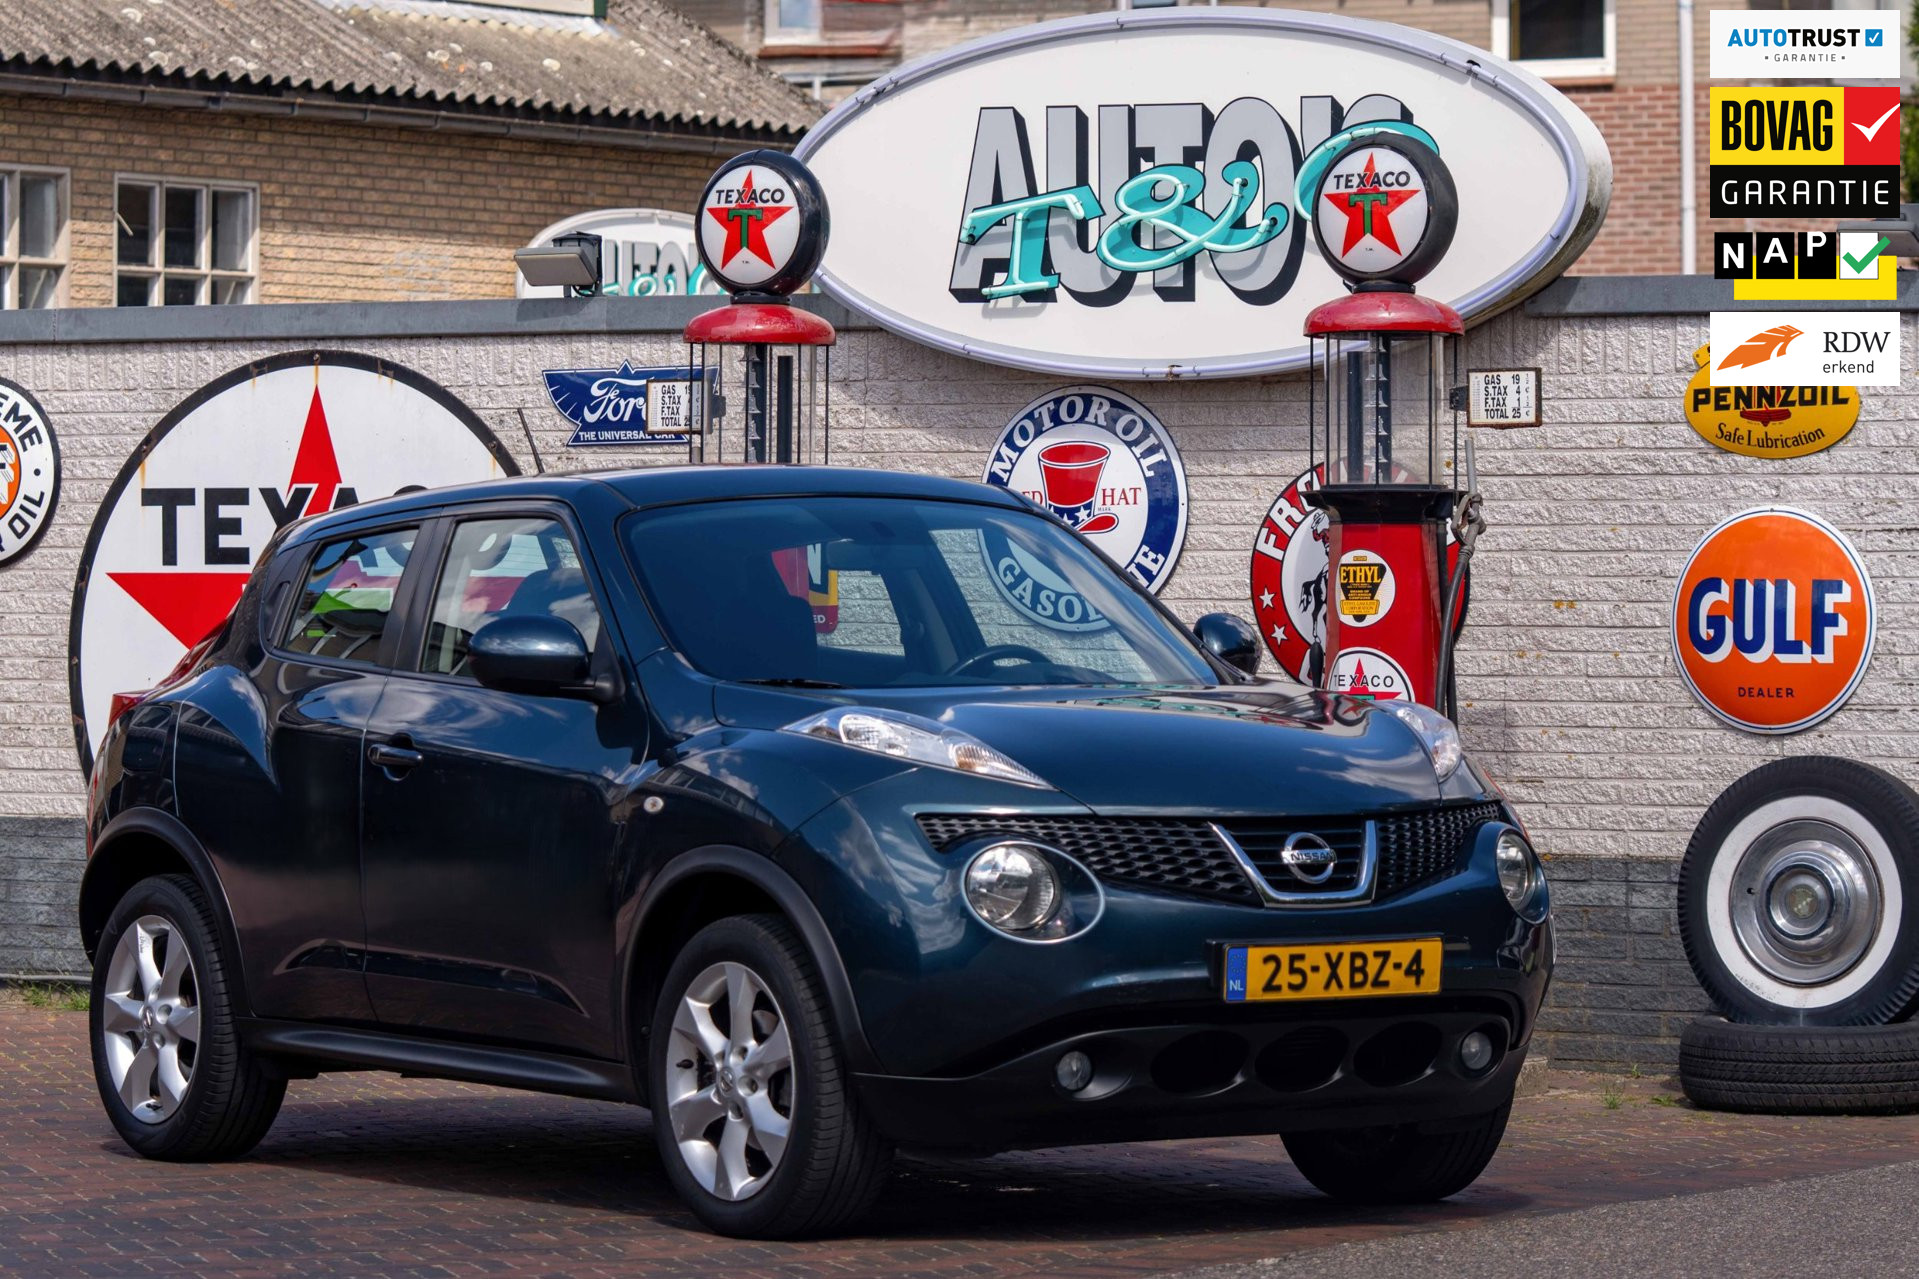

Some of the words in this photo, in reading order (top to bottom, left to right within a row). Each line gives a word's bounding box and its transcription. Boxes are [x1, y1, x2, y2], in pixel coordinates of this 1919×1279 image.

[1333, 170, 1411, 190] TEXACO
[715, 188, 785, 205] TEXACO
[1484, 374, 1501, 385] GAS
[1511, 374, 1521, 385] 19
[661, 384, 676, 395] GAS
[1484, 386, 1508, 396] S.TAX
[1516, 386, 1521, 396] 4
[583, 377, 647, 424] For
[661, 395, 682, 406] S.TAX
[1484, 397, 1507, 408] F.TAX
[1517, 397, 1521, 407] 1
[1692, 385, 1850, 412] PENNZOIL
[661, 406, 680, 416] F.TAX
[1485, 408, 1509, 419] TOTAL
[1512, 408, 1521, 418] 25
[661, 416, 682, 427] TOTAL
[579, 431, 597, 441] THE
[598, 430, 651, 441] UNIVERSAL
[991, 395, 1111, 483] MOTOR
[1115, 413, 1168, 478] OIL
[1715, 422, 1745, 445] Safe
[1747, 427, 1826, 448] Lubrication
[1101, 487, 1142, 506] HAT
[8, 491, 45, 540] OIL
[1340, 565, 1381, 583] ETHYL
[1688, 576, 1848, 660] GULF
[1333, 674, 1394, 688] TEXACO
[1738, 687, 1795, 698] DEALER
[1290, 851, 1334, 861] NISSAN
[1229, 980, 1244, 991] NL
[1262, 949, 1425, 993] 25-XBZ-4
